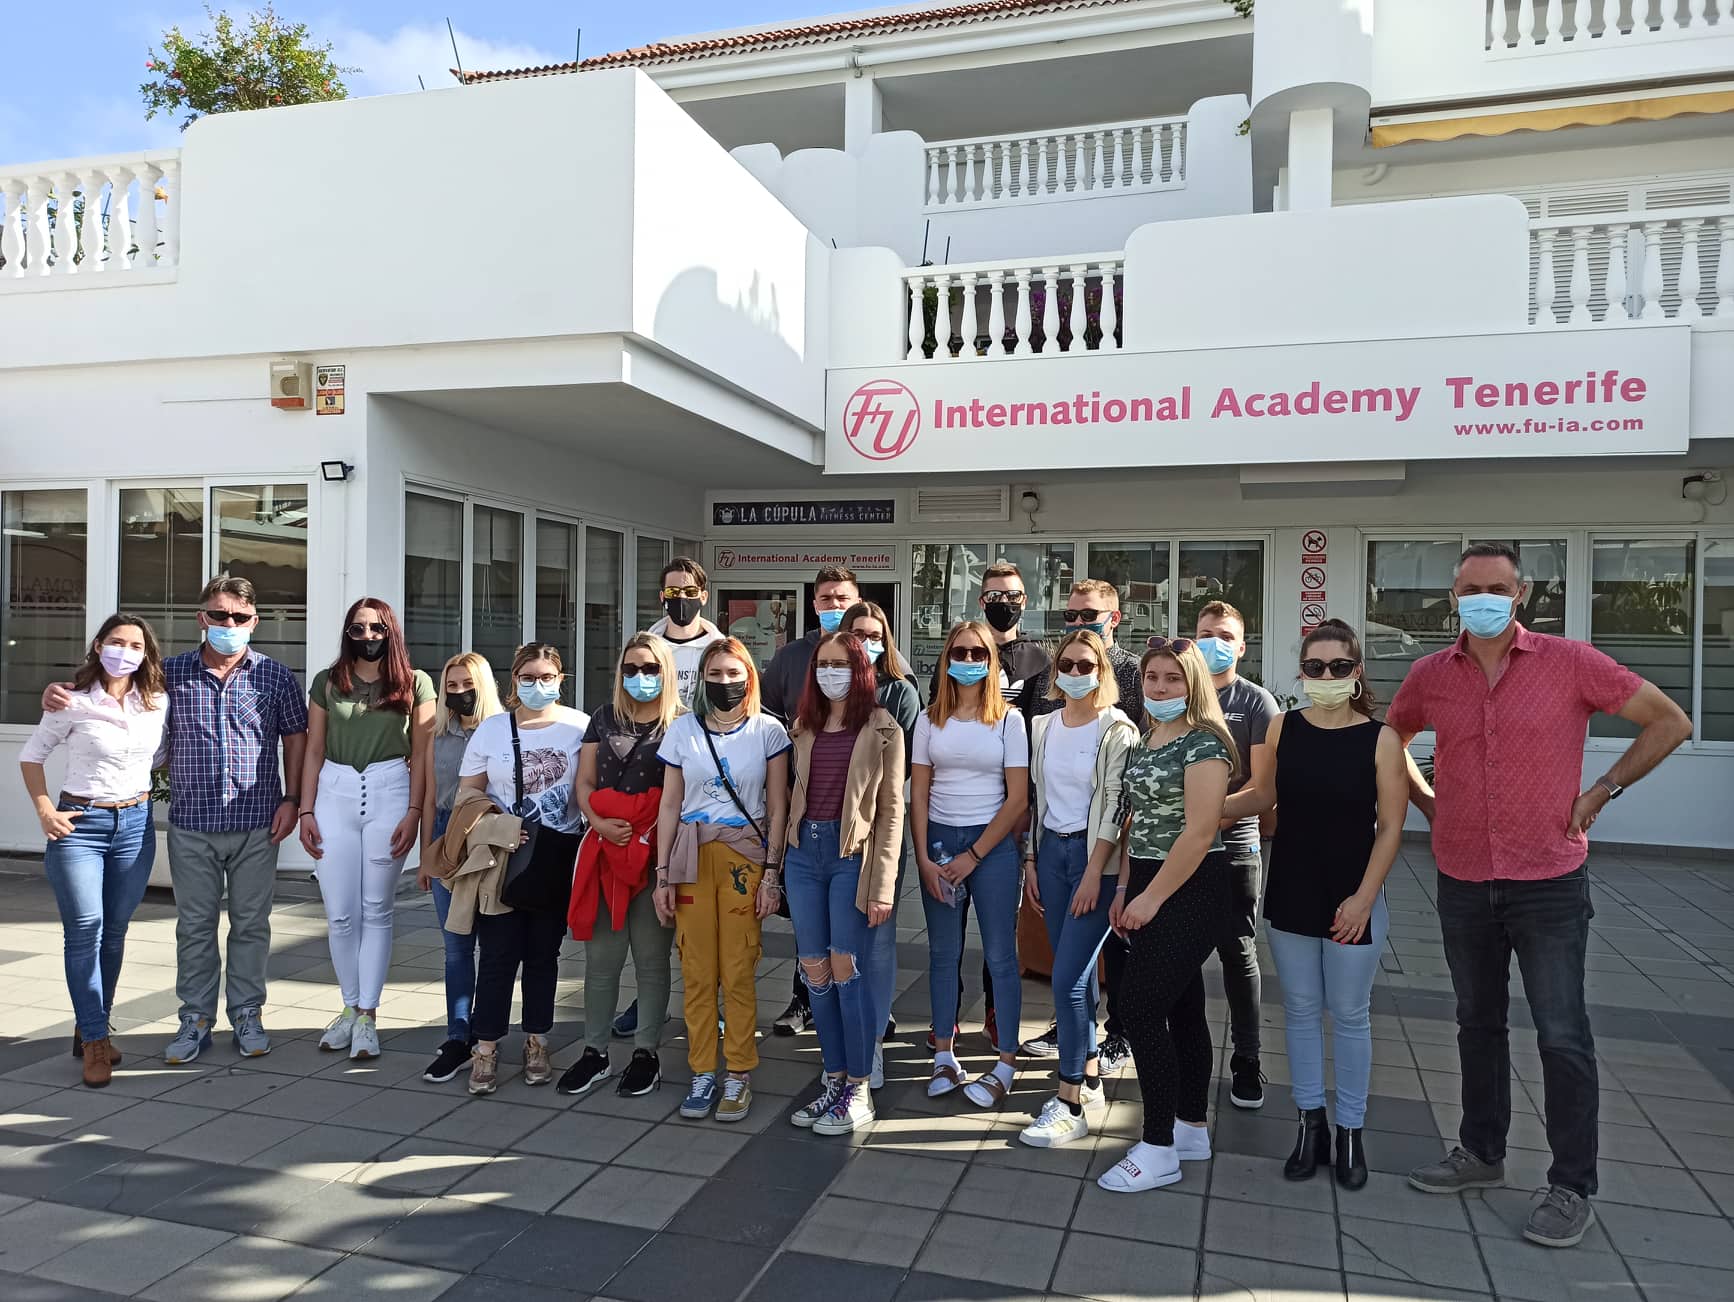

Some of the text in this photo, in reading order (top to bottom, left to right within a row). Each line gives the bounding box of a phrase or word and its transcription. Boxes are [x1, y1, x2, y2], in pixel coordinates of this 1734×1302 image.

[934, 370, 1647, 429] International Academy Tenerife
[1454, 417, 1644, 436] www.fu-ia.com
[741, 504, 816, 522] LA CÚPULA
[859, 512, 891, 520] CENTER
[738, 553, 890, 565] International Academy Tenerife
